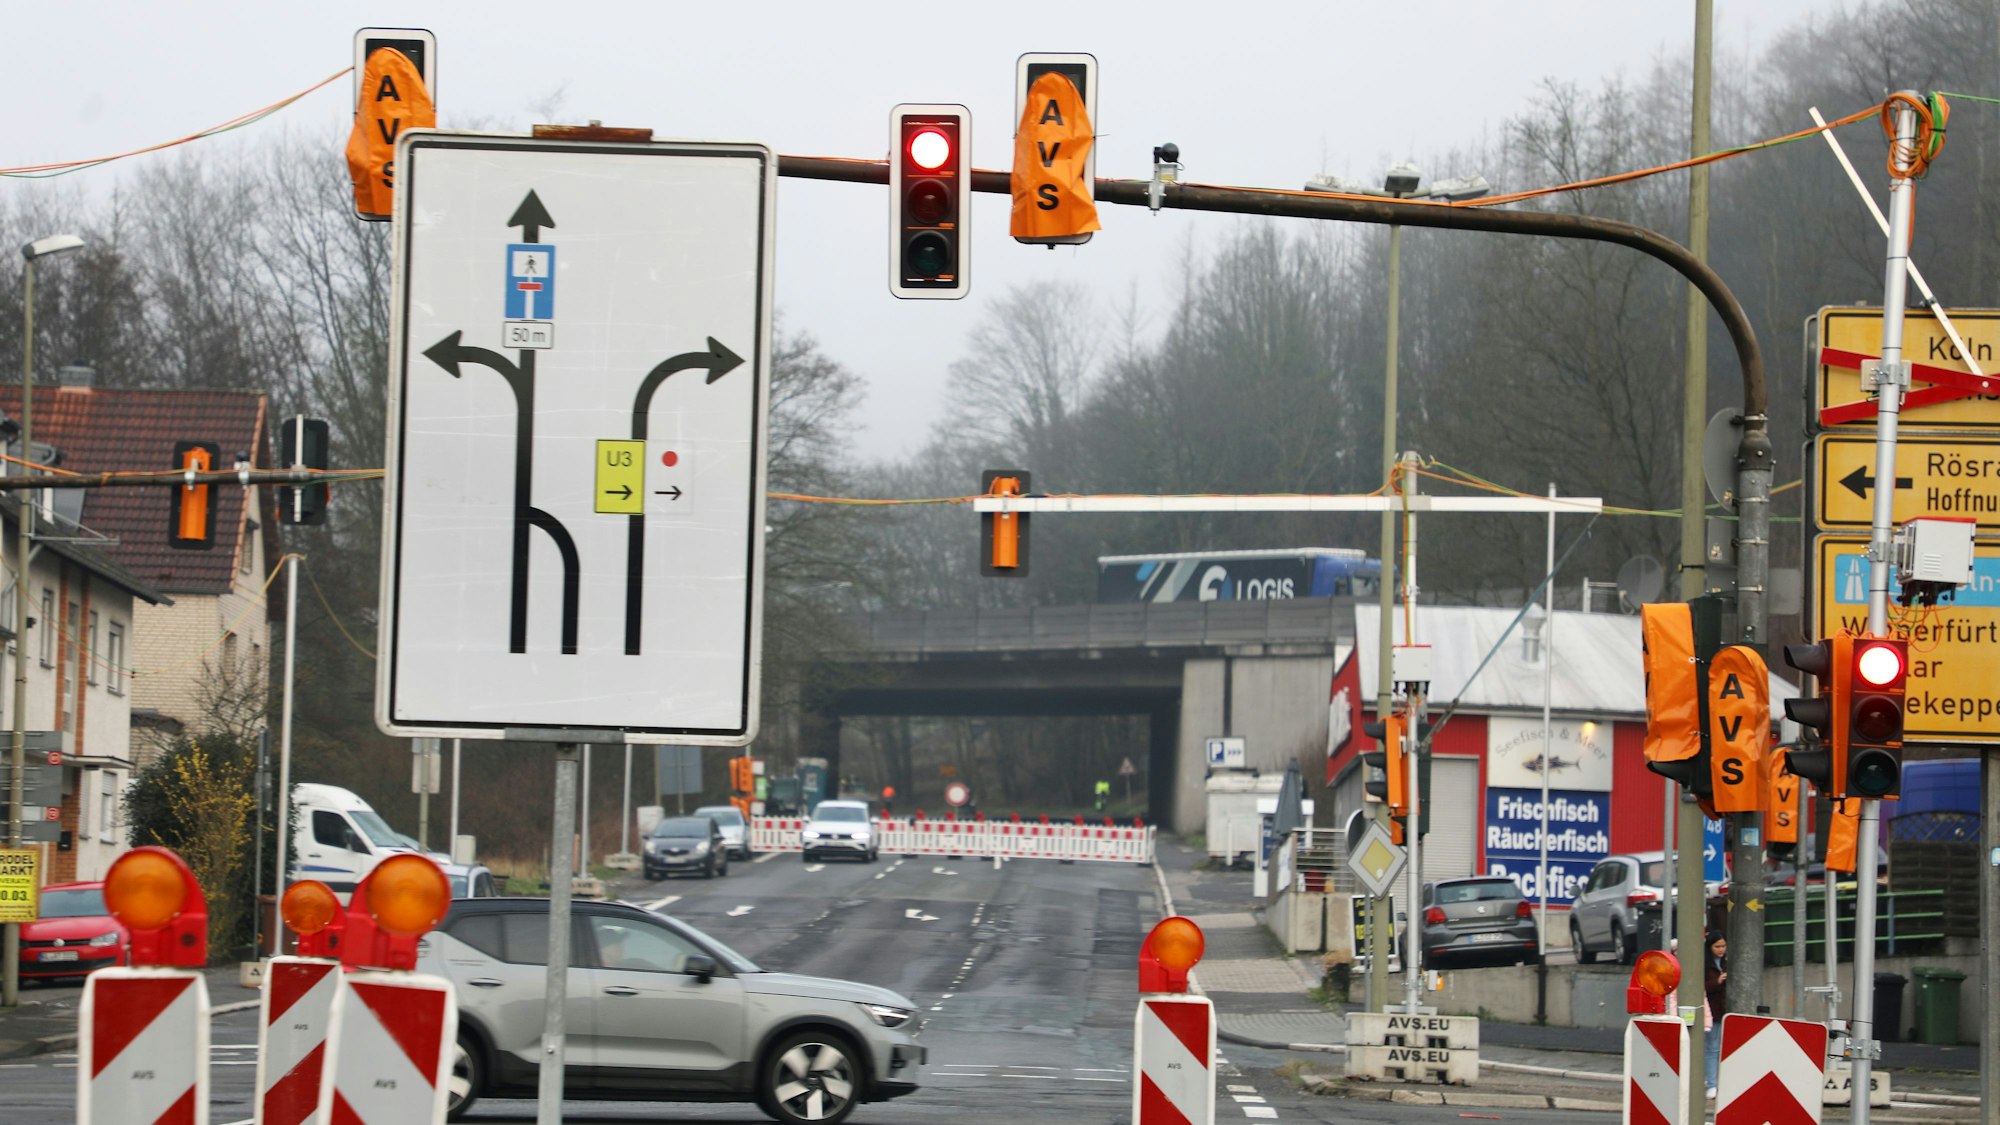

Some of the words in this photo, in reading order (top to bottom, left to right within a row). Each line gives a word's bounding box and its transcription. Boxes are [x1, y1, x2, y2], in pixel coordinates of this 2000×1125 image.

[1036, 98, 1064, 211] AVS
[511, 327, 530, 342] 50
[532, 331, 546, 343] m
[607, 451, 633, 467] U3
[1928, 453, 2000, 477] Rösr
[1928, 487, 2000, 512] Hoffnu
[1560, 727, 1569, 739] &
[1719, 673, 1745, 785] AVS
[1777, 762, 1792, 827] AVS
[0, 866, 34, 875] ARKT
[1388, 1017, 1450, 1031] AVS.EU
[1388, 1049, 1450, 1063] AVS.EU
